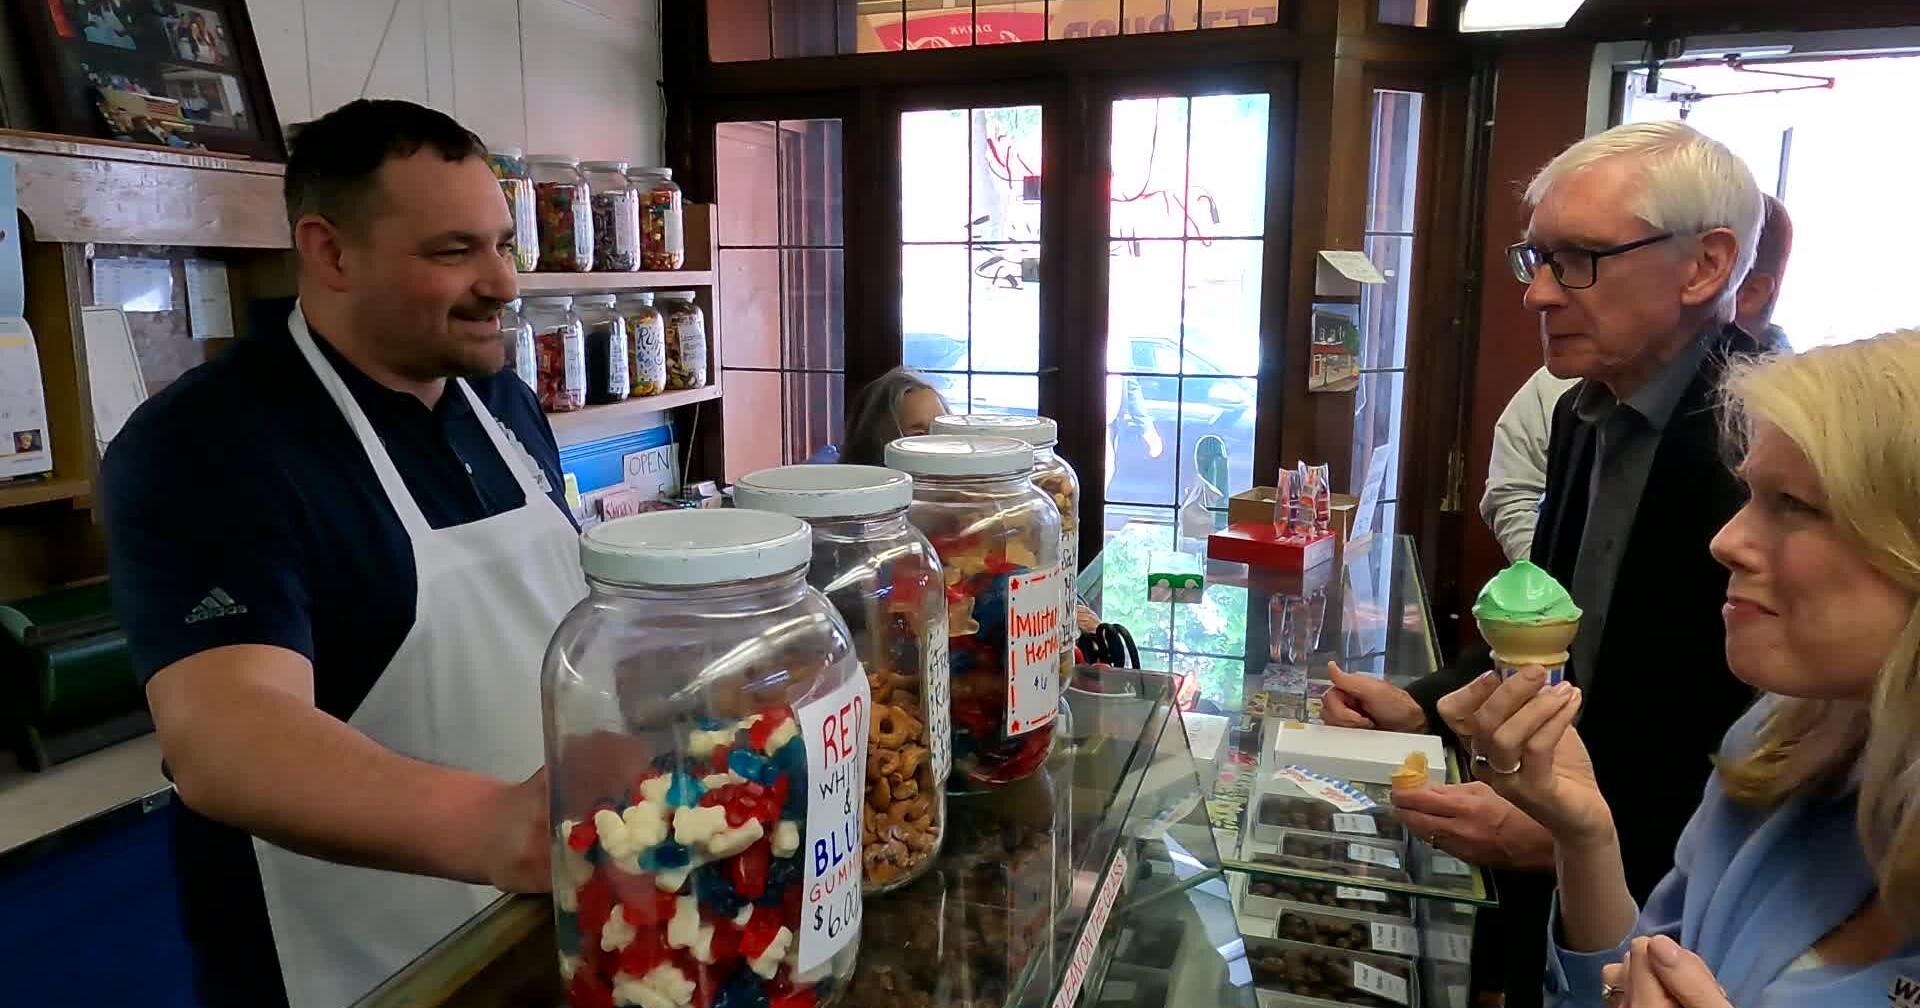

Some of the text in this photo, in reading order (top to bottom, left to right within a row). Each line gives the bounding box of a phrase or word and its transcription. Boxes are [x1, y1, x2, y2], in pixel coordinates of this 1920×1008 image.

[629, 447, 669, 476] OPEN
[184, 604, 248, 624] adidas
[823, 696, 863, 770] RED
[1080, 936, 1094, 965] ON
